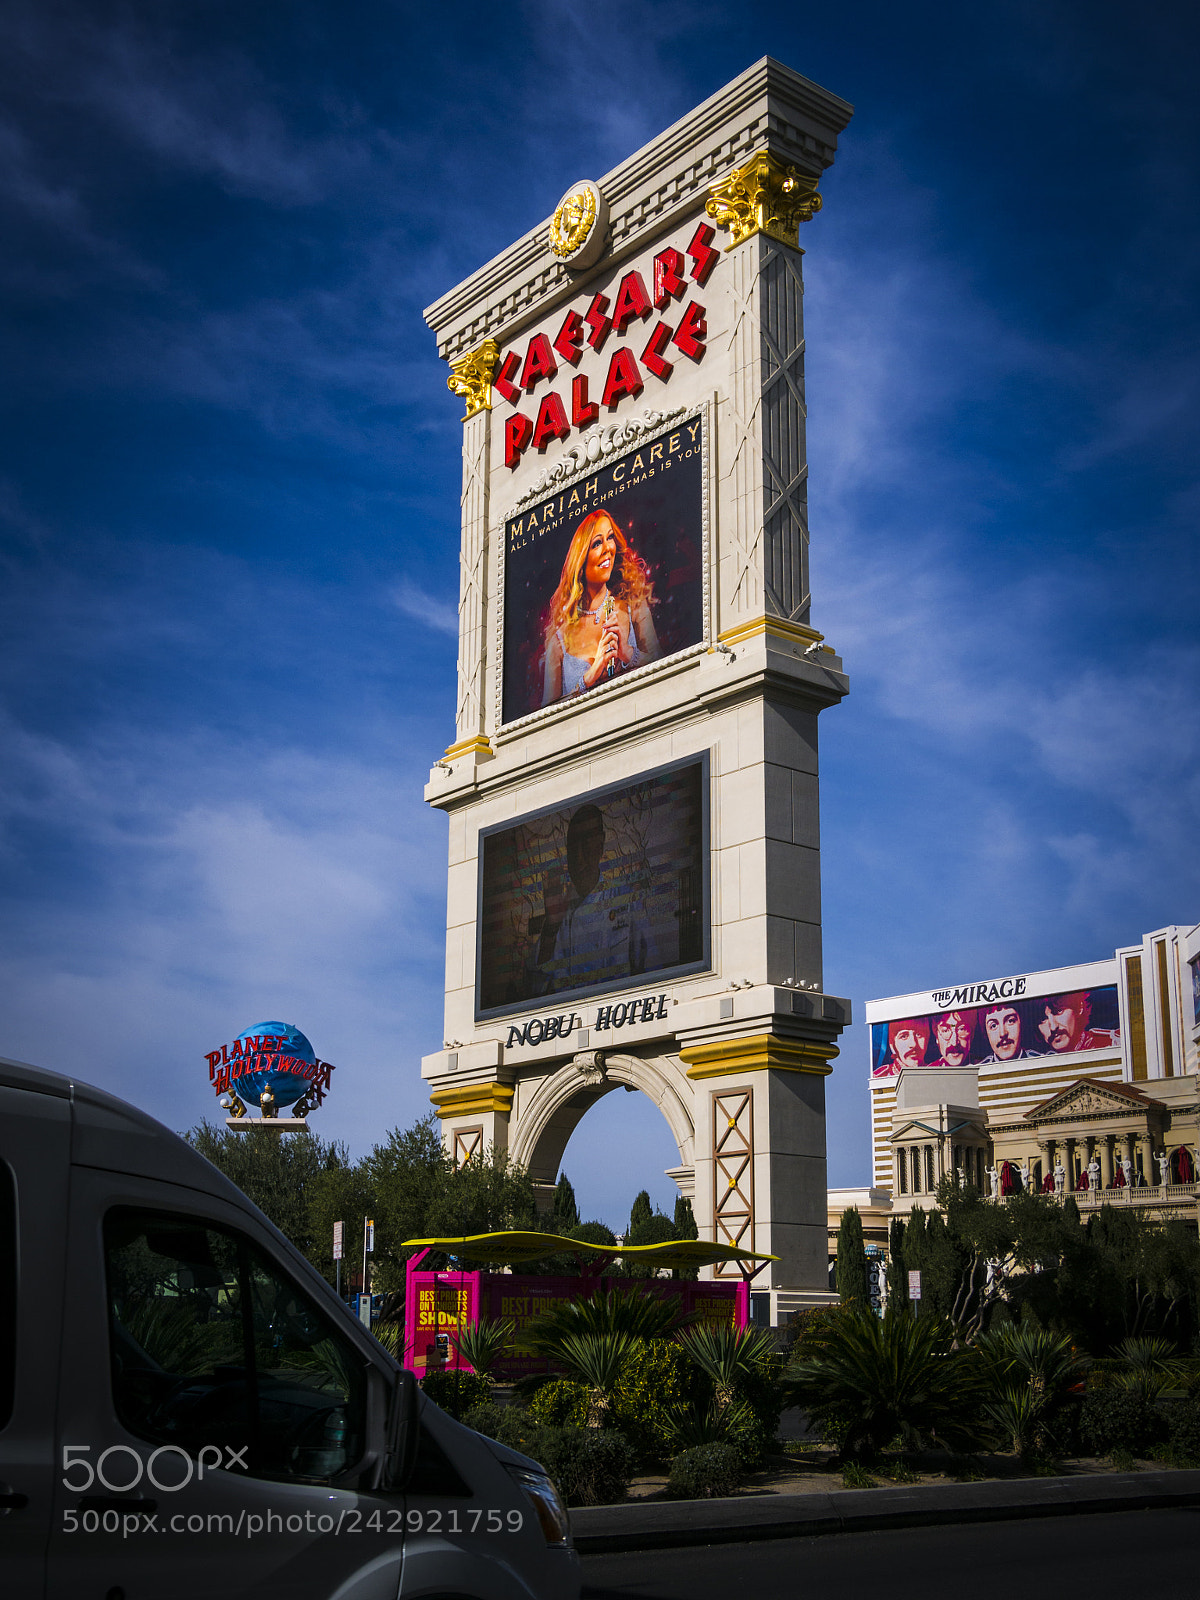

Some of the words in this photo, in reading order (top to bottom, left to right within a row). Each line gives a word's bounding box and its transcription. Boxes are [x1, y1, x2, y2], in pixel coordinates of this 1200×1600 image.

[494, 221, 720, 404] CAESARS
[505, 301, 707, 468] PALACE
[510, 477, 599, 541] MARIAH
[612, 421, 701, 482] CAREY
[511, 540, 528, 553] ALL
[538, 520, 564, 537] WANT
[568, 504, 588, 520] FOR
[592, 468, 655, 506] CHRISTMAS
[660, 459, 673, 472] IS
[677, 444, 701, 462] YOU
[932, 990, 951, 1002] THE
[938, 977, 1027, 1009] MIRAGE
[505, 1012, 578, 1049] NOBU
[594, 994, 669, 1031] HOTEL
[204, 1035, 289, 1081] PLANET
[212, 1053, 329, 1097] HOLLYWOOD
[420, 1290, 440, 1301] BEST
[440, 1290, 468, 1301] PRICES
[420, 1301, 430, 1311] ON
[501, 1297, 529, 1315] BEST
[419, 1311, 468, 1325] SHOWS
